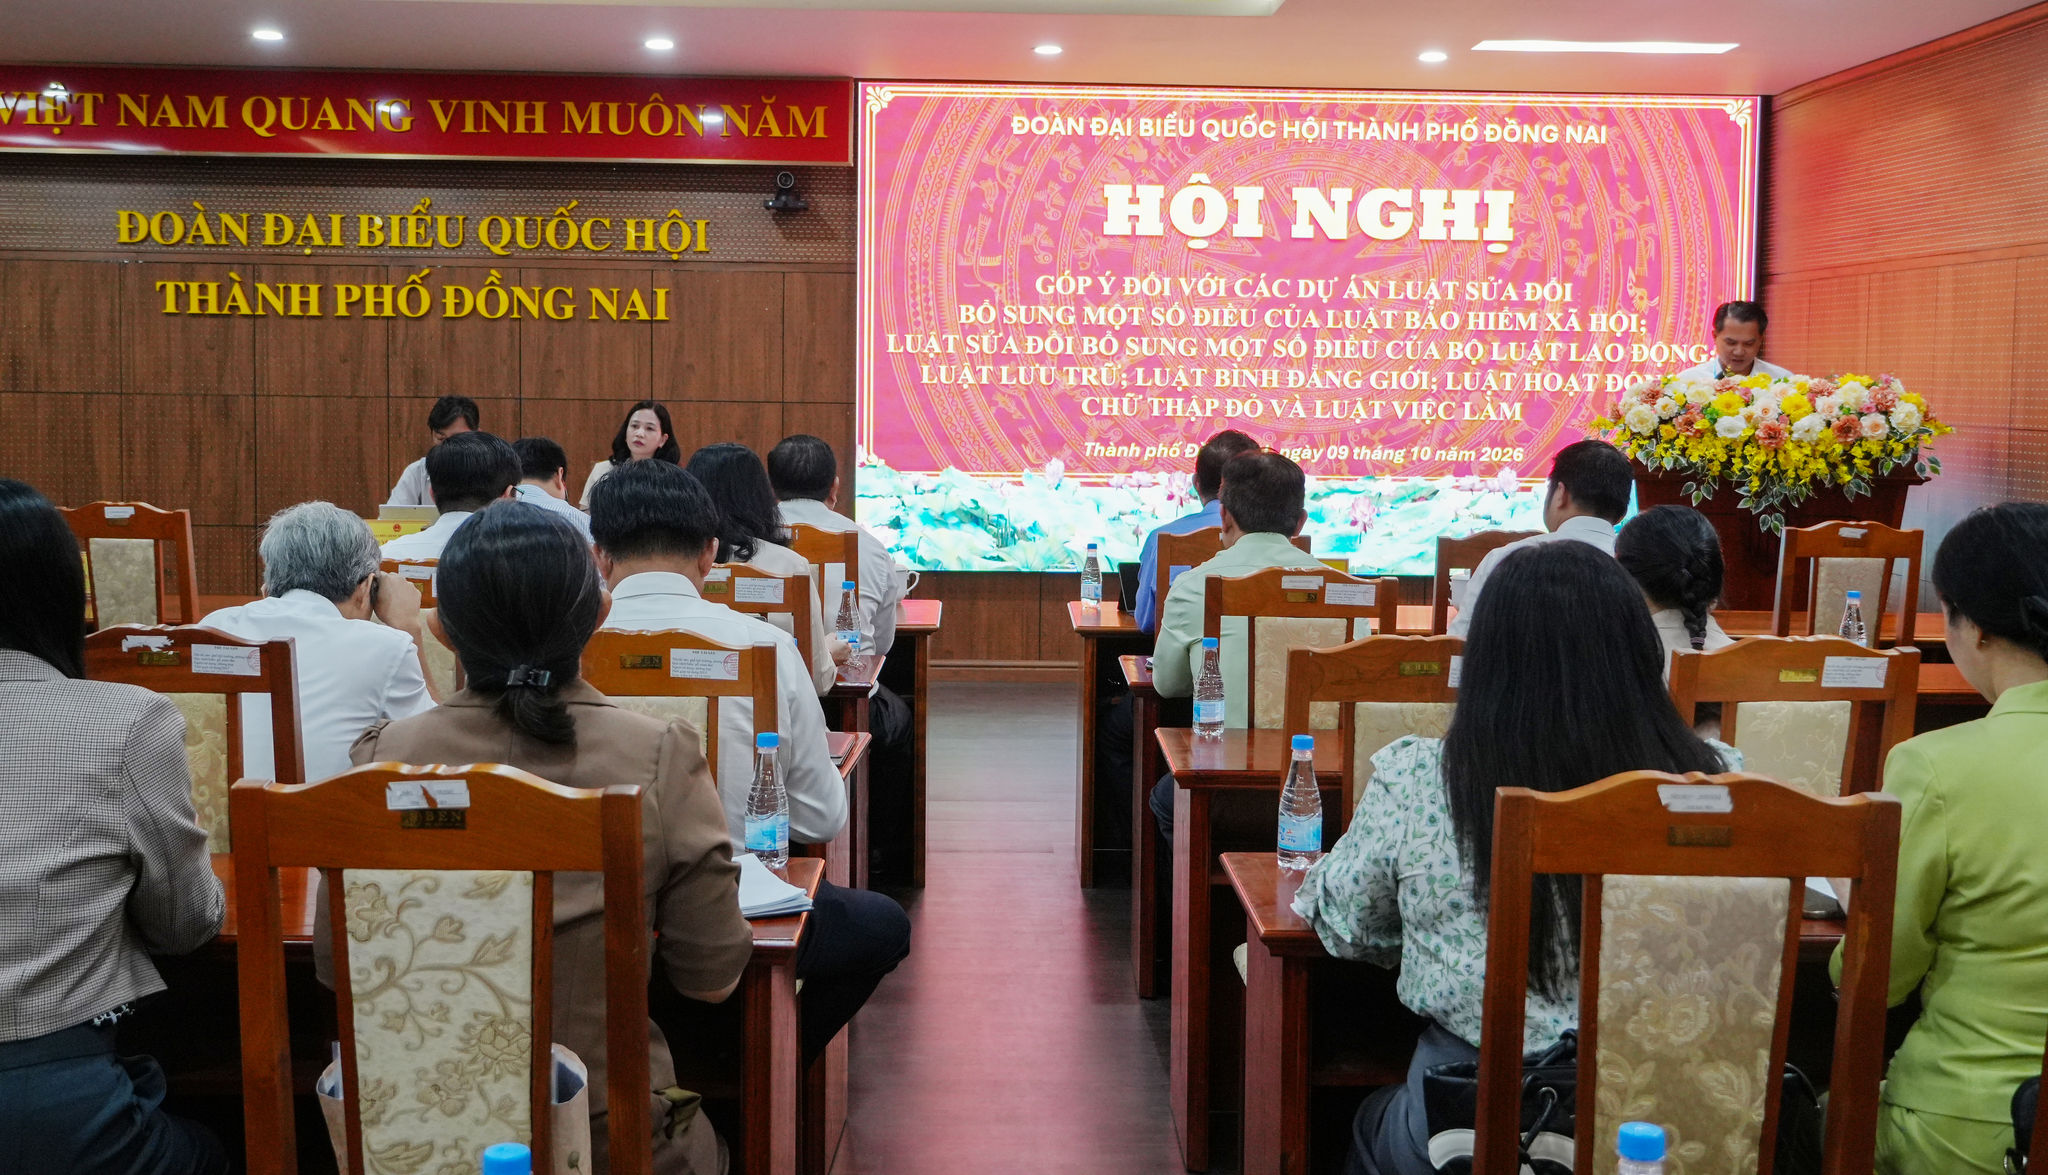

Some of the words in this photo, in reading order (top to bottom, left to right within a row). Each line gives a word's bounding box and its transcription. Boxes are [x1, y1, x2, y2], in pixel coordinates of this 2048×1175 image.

[117, 93, 229, 128] NAM
[241, 95, 415, 138] QUANG
[427, 99, 549, 134] VINH
[561, 92, 706, 137] MUÔN
[721, 95, 828, 138] NĂM
[1011, 113, 1084, 136] ĐOÀN
[1090, 117, 1132, 141] ĐẠI
[1139, 111, 1195, 138] BIỂU
[1202, 113, 1276, 142] QUỐC
[1282, 116, 1327, 143] HỘI
[1333, 117, 1419, 142] THÀNH
[1426, 117, 1478, 142] PHỐ
[1484, 117, 1559, 143] ĐỒNG
[1565, 125, 1607, 144] NAI
[116, 201, 249, 246] ĐOÀN
[261, 213, 345, 255] ĐẠI
[357, 197, 466, 248] BIỂU
[478, 200, 612, 255] QUỐC
[624, 209, 710, 260] HỘI
[1103, 172, 1264, 249] HỘI
[1291, 187, 1515, 253] NGHỊ
[155, 271, 323, 316] THÀNH
[333, 268, 431, 318] PHỐ
[442, 269, 577, 320] ĐỒNG
[589, 288, 670, 321] NAI
[1035, 271, 1092, 296] GÓP
[1098, 271, 1116, 296] Ý
[1123, 271, 1171, 297] ĐỐI
[1179, 272, 1226, 297] VỚI
[1233, 272, 1291, 298] CÁC
[1296, 276, 1339, 303] DỰ
[1342, 274, 1380, 299] ÁN
[1388, 279, 1459, 305] LUẬT
[1465, 277, 1519, 301] SỬA
[1524, 277, 1573, 301] ĐỔI
[959, 300, 997, 324] BỔ
[1003, 305, 1076, 325] SUNG
[1082, 303, 1144, 330] MỘT
[1151, 302, 1186, 327] SỐ
[1192, 304, 1257, 327] ĐIỀU
[1264, 303, 1320, 328] CỦA
[1326, 307, 1398, 333] LUẬT
[1404, 304, 1460, 330] BẢO
[1467, 306, 1538, 331] HIỂM
[1544, 308, 1582, 332] XÃ
[1589, 310, 1647, 337] HỘI;
[887, 331, 959, 358] LUẬT
[966, 330, 1020, 354] SỬA
[1025, 330, 1077, 355] ĐỔI
[1081, 331, 1119, 356] BỔ
[1125, 336, 1198, 356] SUNG
[1205, 335, 1267, 362] MỘT
[1273, 334, 1307, 358] SỐ
[1313, 335, 1378, 359] ĐIỀU
[1385, 336, 1441, 360] CỦA
[1447, 339, 1484, 365] BỘ
[1490, 341, 1562, 365] LUẬT
[1568, 344, 1625, 363] LAO
[920, 362, 994, 389] LUẬT
[1000, 364, 1058, 386] LƯU
[1062, 363, 1128, 389] TRỮ;
[1135, 366, 1207, 391] LUẬT
[1214, 364, 1281, 389] BÌNH
[1286, 365, 1362, 389] ĐẲNG
[1370, 367, 1437, 392] GIỚI;
[1445, 369, 1517, 395] LUẬT
[1524, 371, 1599, 396] HOẠT
[1081, 393, 1142, 416] CHỮ
[1148, 395, 1220, 422] THẬP
[1224, 395, 1263, 418] ĐỎ
[1269, 395, 1306, 418] VÀ
[1313, 396, 1386, 423] LUẬT
[1391, 398, 1455, 424] VIỆC
[1463, 396, 1522, 421] LÀM
[1085, 442, 1140, 457] Thành
[1144, 441, 1182, 460] phố
[1280, 445, 1323, 463] ngày
[1327, 445, 1348, 460] 09
[1353, 444, 1407, 463] tháng
[1411, 446, 1431, 461] 10
[1435, 446, 1476, 461] năm
[1479, 446, 1524, 462] 2026
